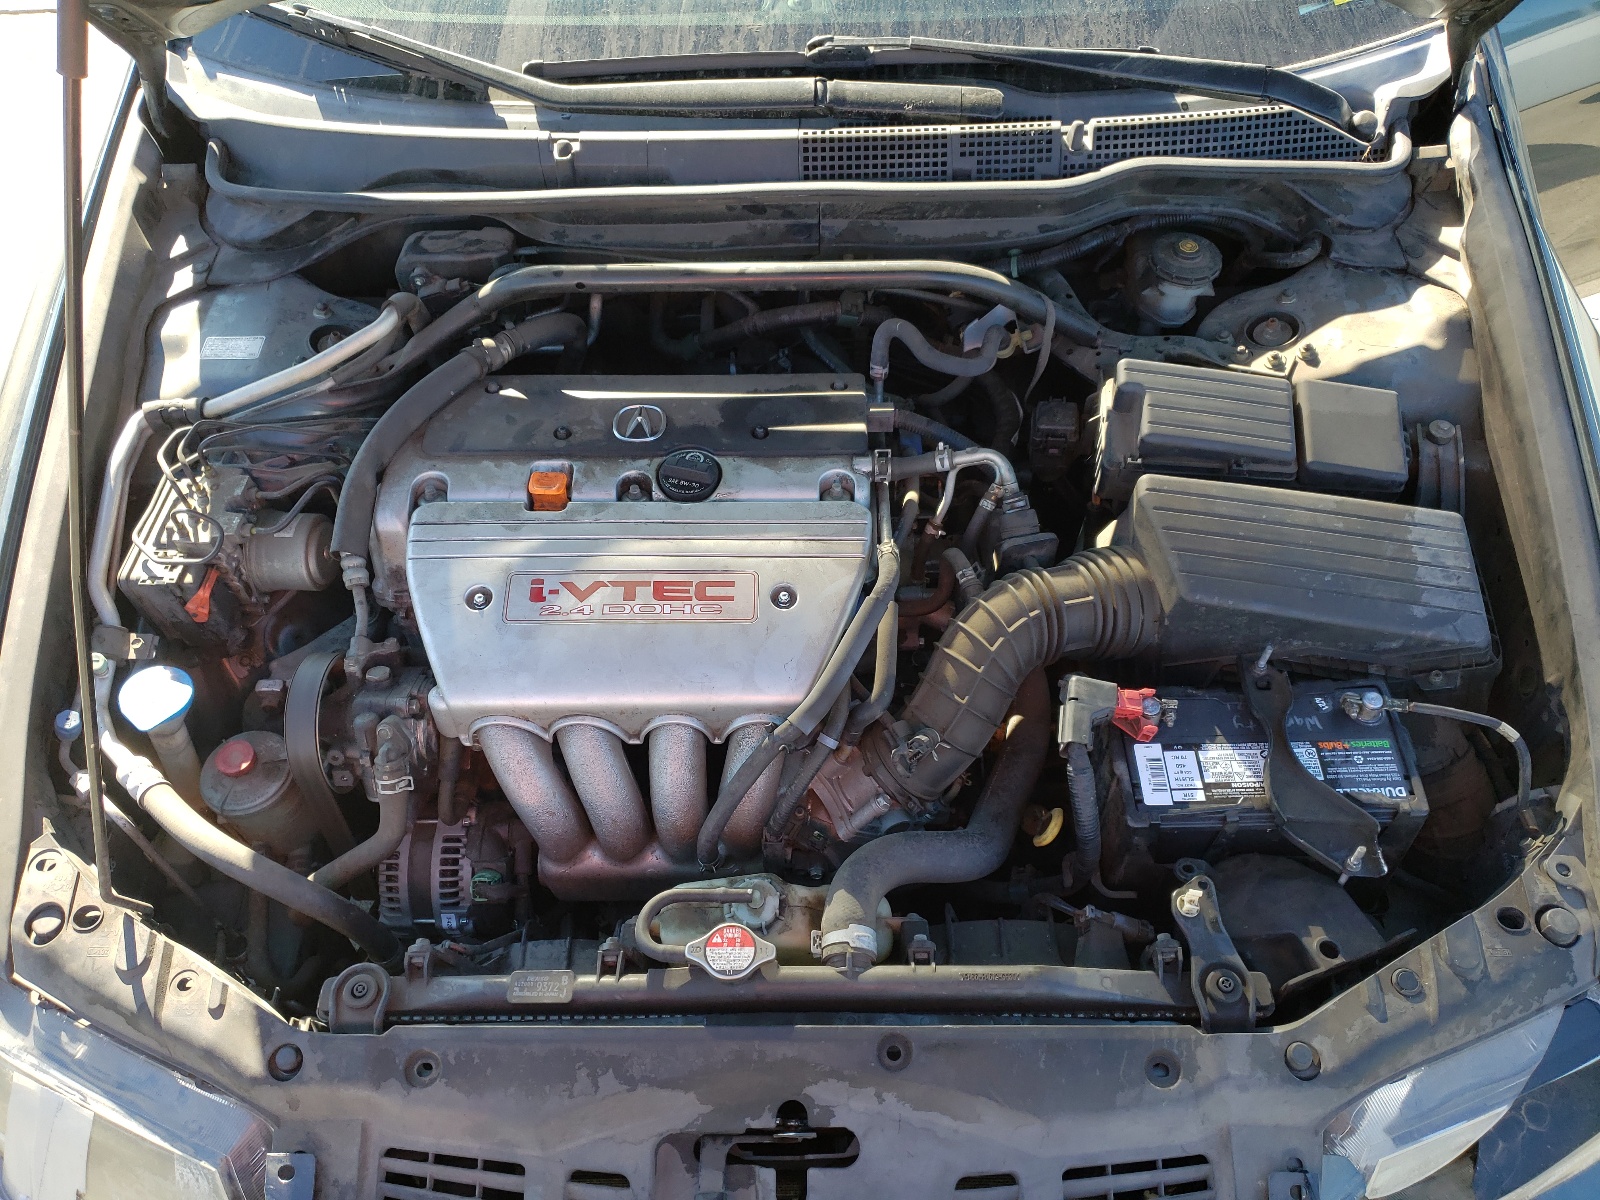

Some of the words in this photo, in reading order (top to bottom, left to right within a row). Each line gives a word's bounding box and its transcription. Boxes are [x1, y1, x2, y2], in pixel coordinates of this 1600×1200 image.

[529, 578, 736, 603] i-VTEC
[539, 604, 594, 616] 2.4
[602, 603, 723, 616] DOHC
[537, 981, 560, 992] 9372
